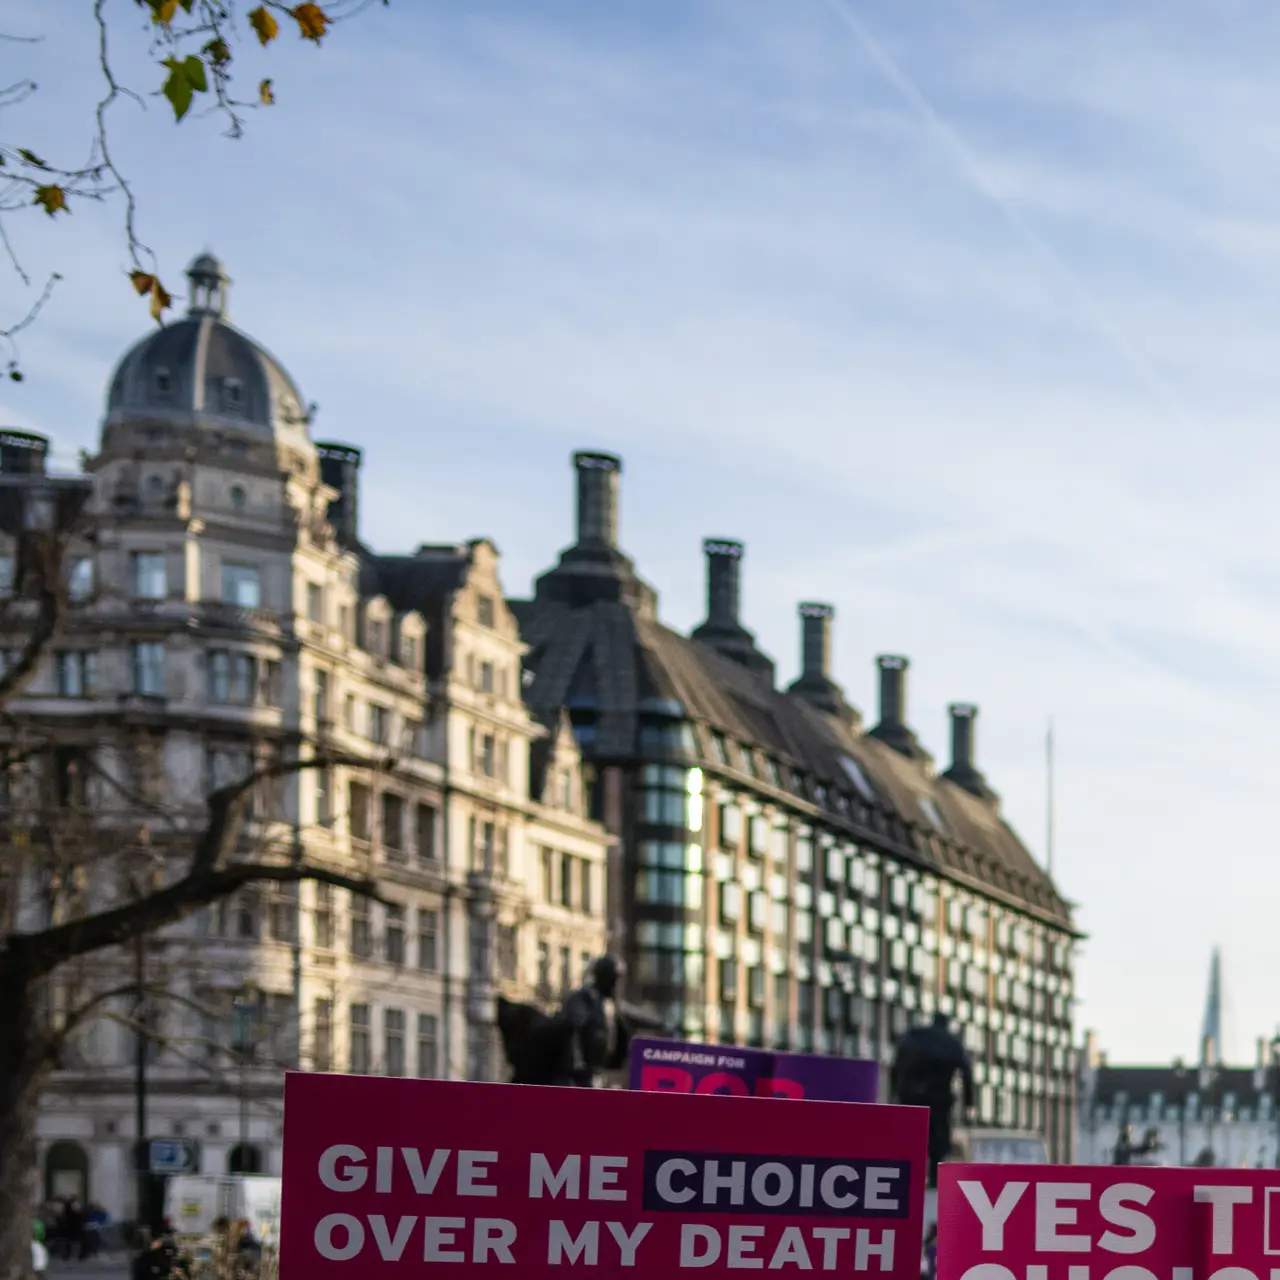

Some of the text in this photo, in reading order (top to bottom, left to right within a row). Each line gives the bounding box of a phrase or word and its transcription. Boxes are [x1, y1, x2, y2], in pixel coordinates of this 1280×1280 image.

[643, 1049, 745, 1068] CAMPAIGN FOR
[317, 1144, 900, 1210] GIVE ME CHOICE
[314, 1213, 897, 1272] OVER MY DEATH
[957, 1181, 1156, 1255] YES
